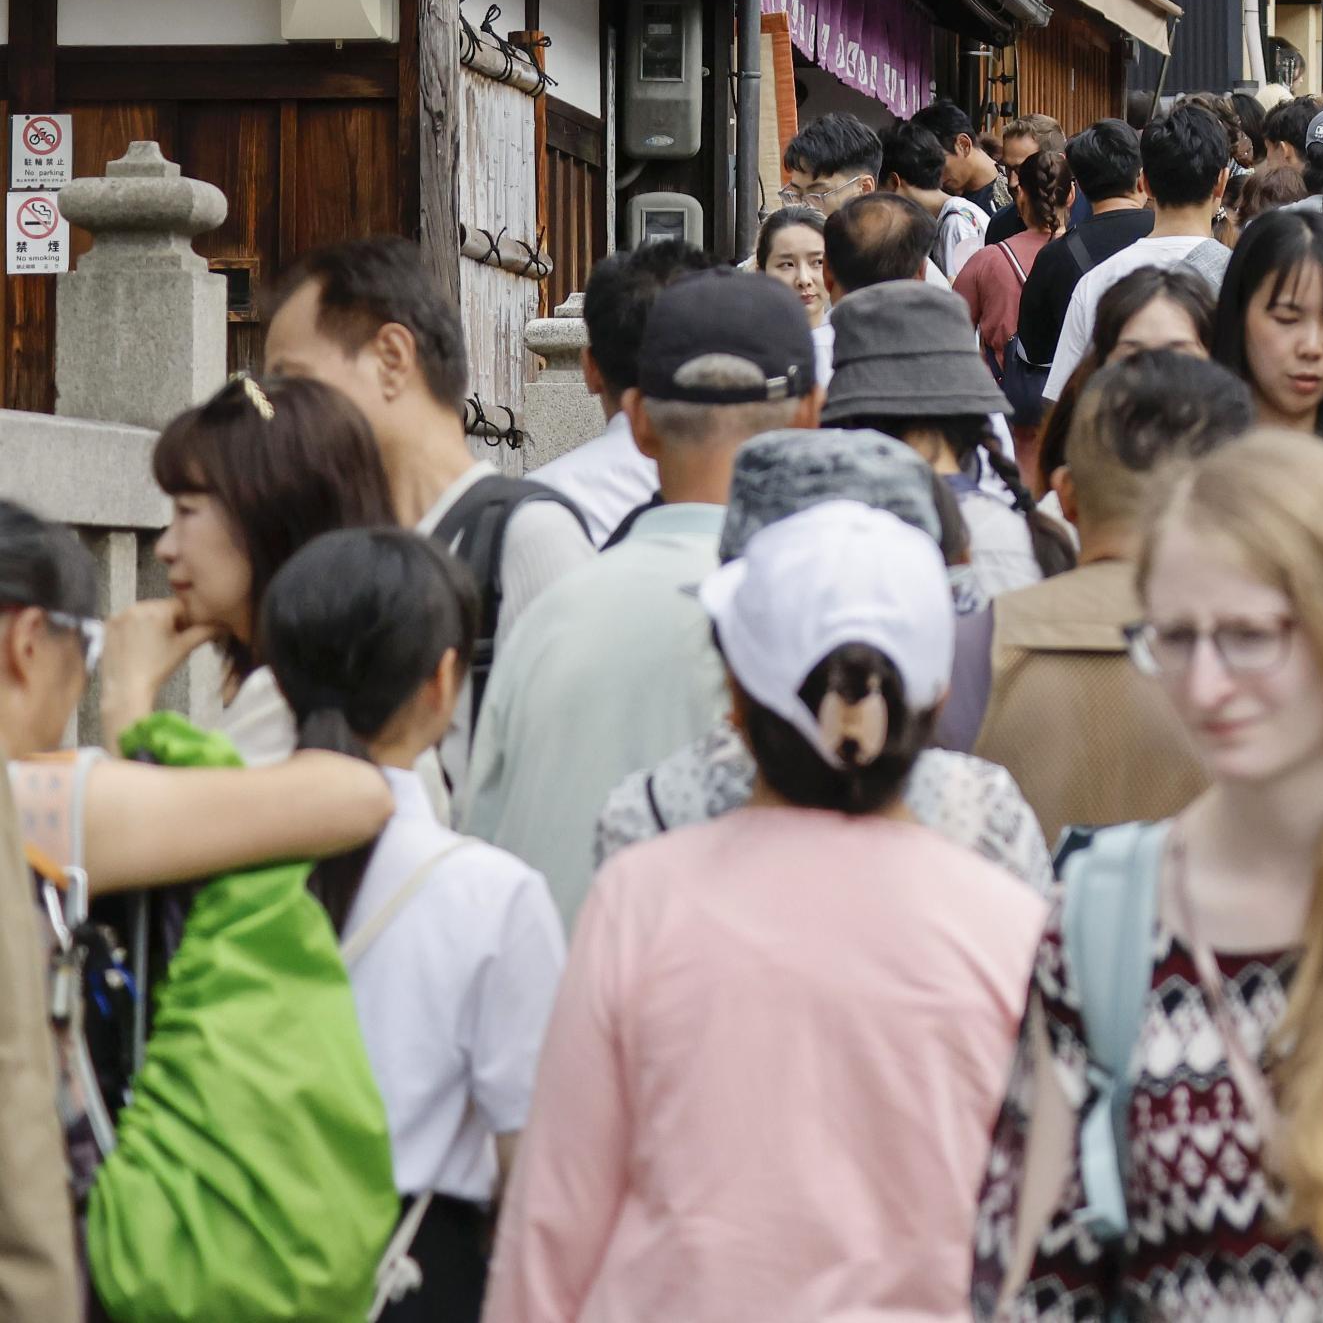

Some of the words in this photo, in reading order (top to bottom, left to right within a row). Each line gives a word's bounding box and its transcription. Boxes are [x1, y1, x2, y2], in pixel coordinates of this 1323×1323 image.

[24, 158, 65, 166] 駐輪禁止
[39, 168, 65, 177] parking
[16, 240, 60, 253] 禁煙
[28, 255, 60, 263] smoking
